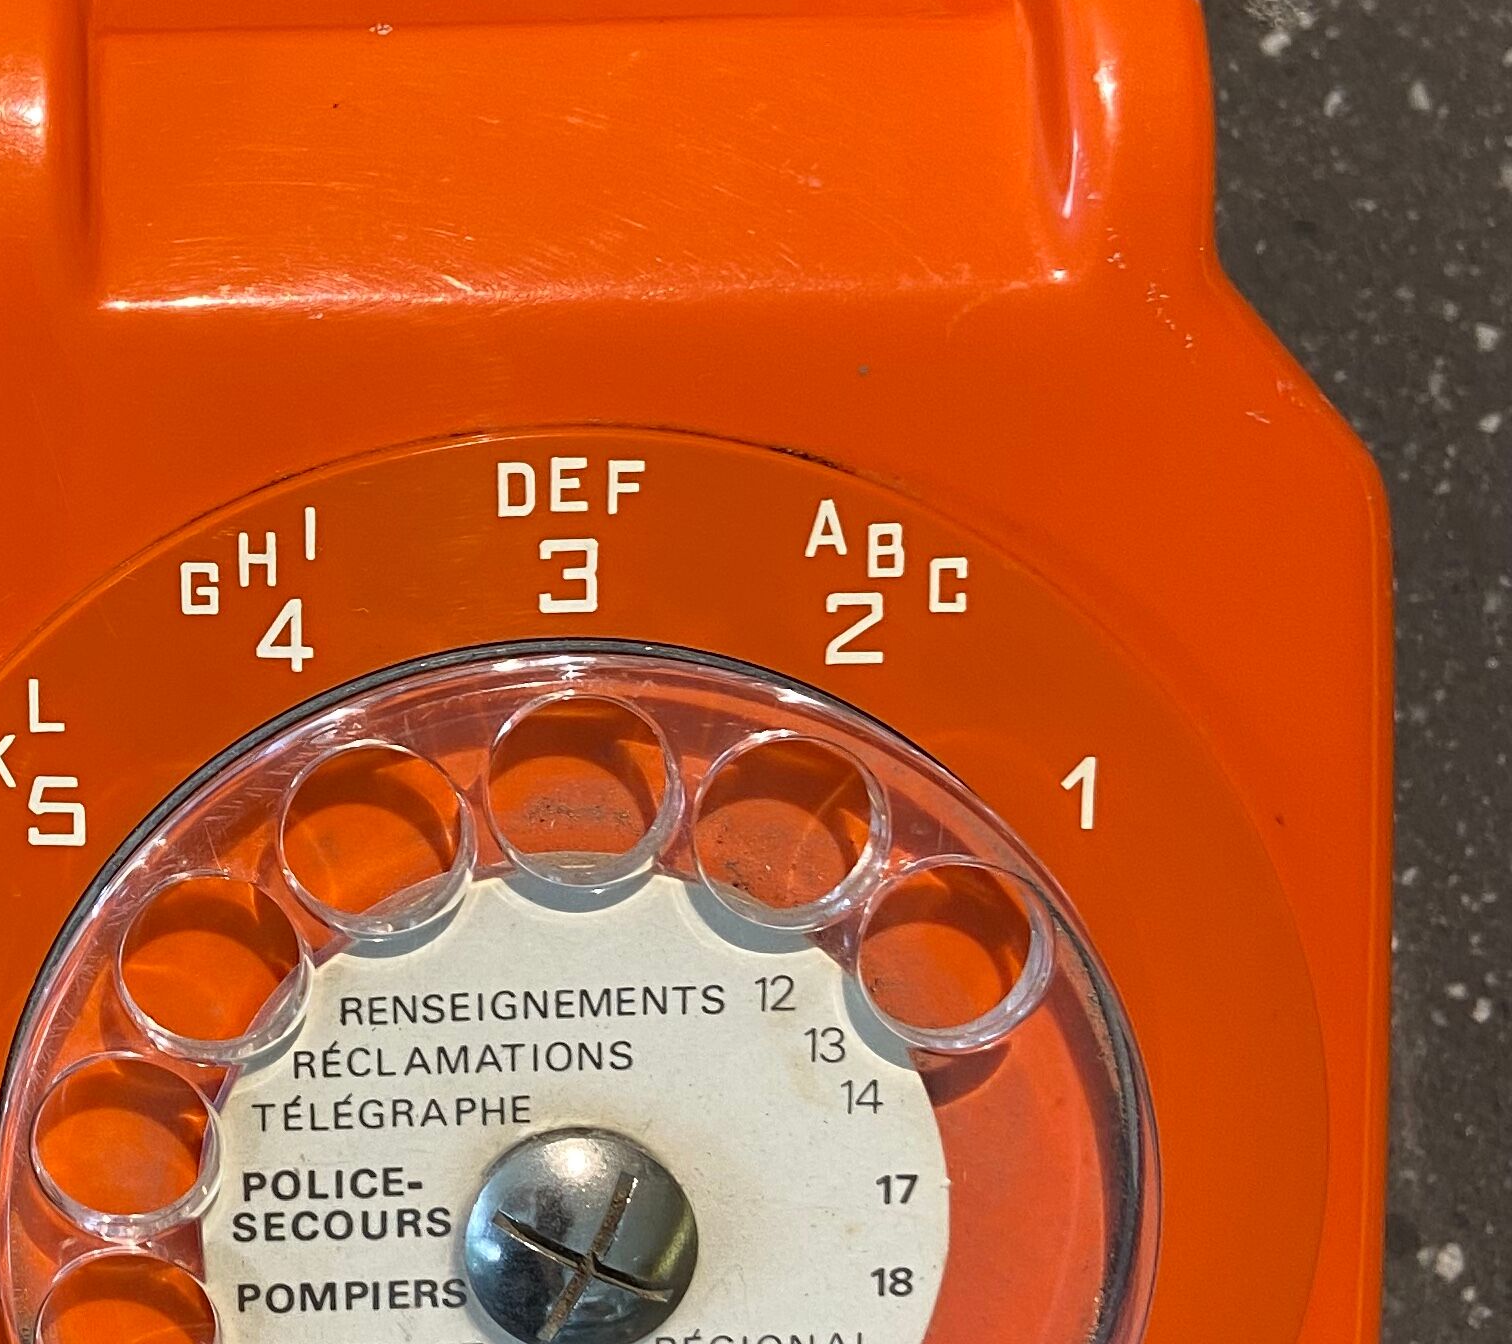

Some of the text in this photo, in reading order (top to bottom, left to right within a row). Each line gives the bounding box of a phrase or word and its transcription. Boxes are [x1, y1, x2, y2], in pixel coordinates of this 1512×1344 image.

[498, 457, 645, 517] DEF
[539, 538, 598, 613] 3
[256, 599, 313, 672] 4
[826, 592, 883, 664] 2
[28, 776, 85, 846] 5
[1062, 757, 1096, 829] 1
[340, 975, 795, 1026] RENSEIGNEMENTS 12
[292, 1027, 845, 1079] RÉCLAMATIONS 13
[251, 1080, 883, 1132] TÉLÉGRAPHE 14
[243, 1167, 917, 1204] POLICE- 17
[233, 1208, 451, 1242] SECOURS
[238, 1268, 912, 1313] POMPIERS 18
